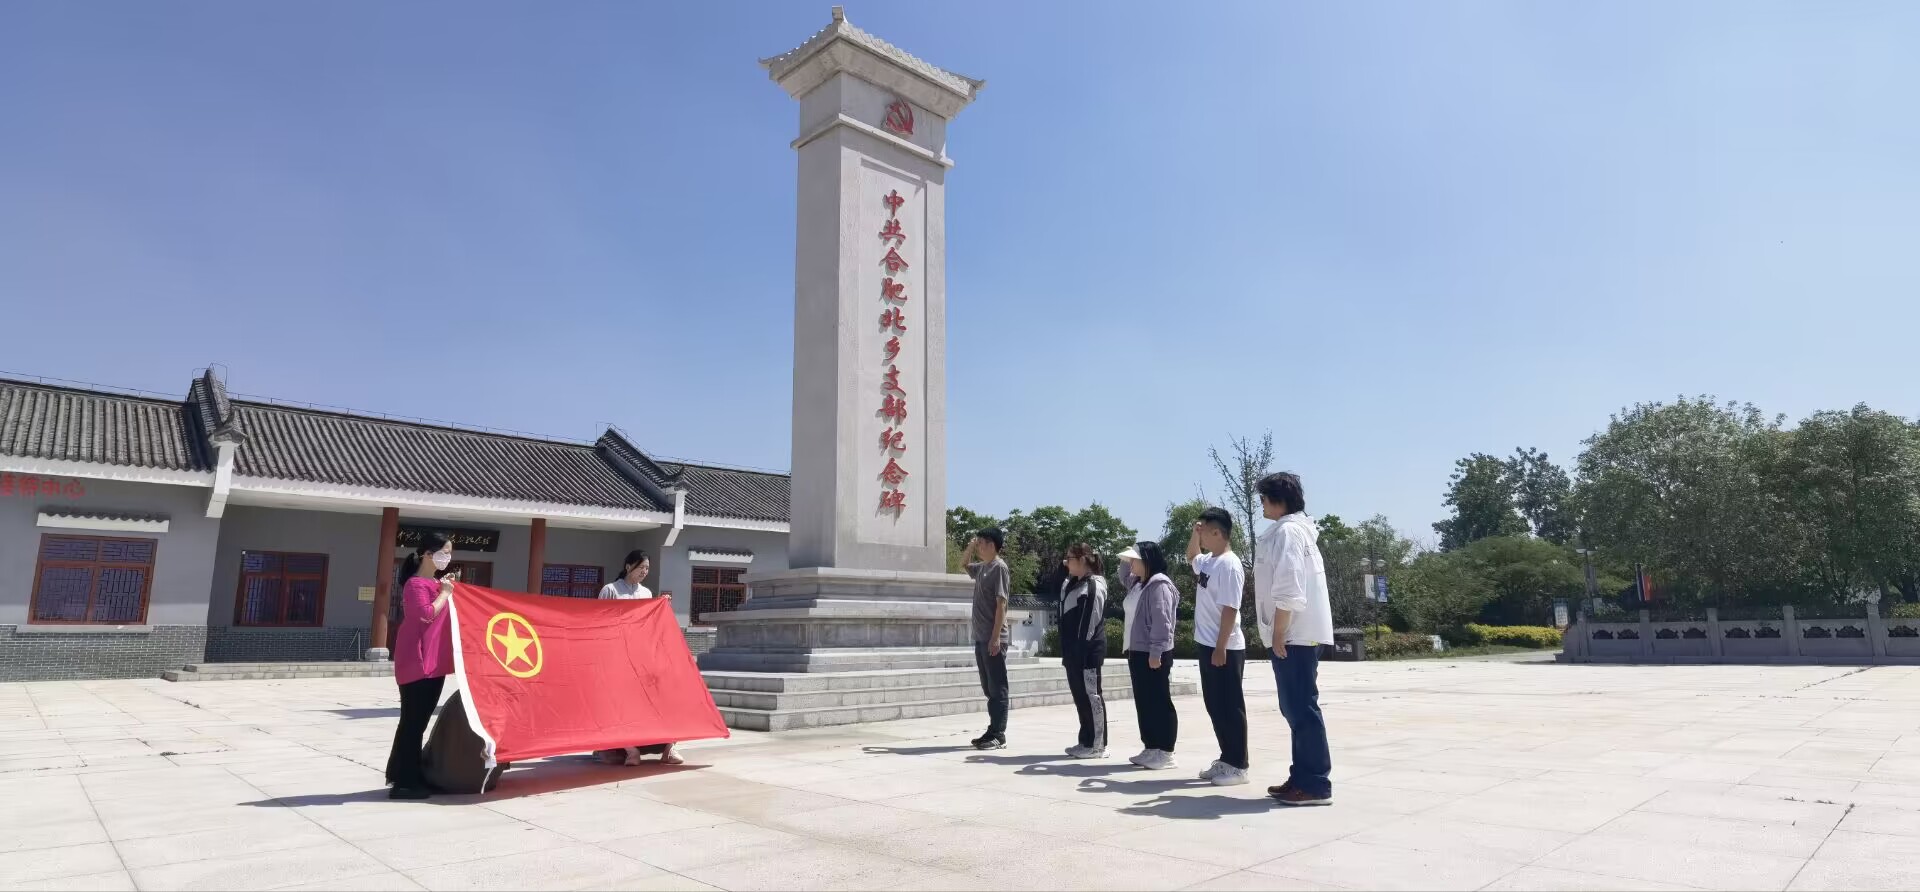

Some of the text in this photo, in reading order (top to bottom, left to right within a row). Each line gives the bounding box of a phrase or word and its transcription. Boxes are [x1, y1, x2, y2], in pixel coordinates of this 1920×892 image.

[878, 189, 909, 514] 中共合肥北乡支部纪念碑
